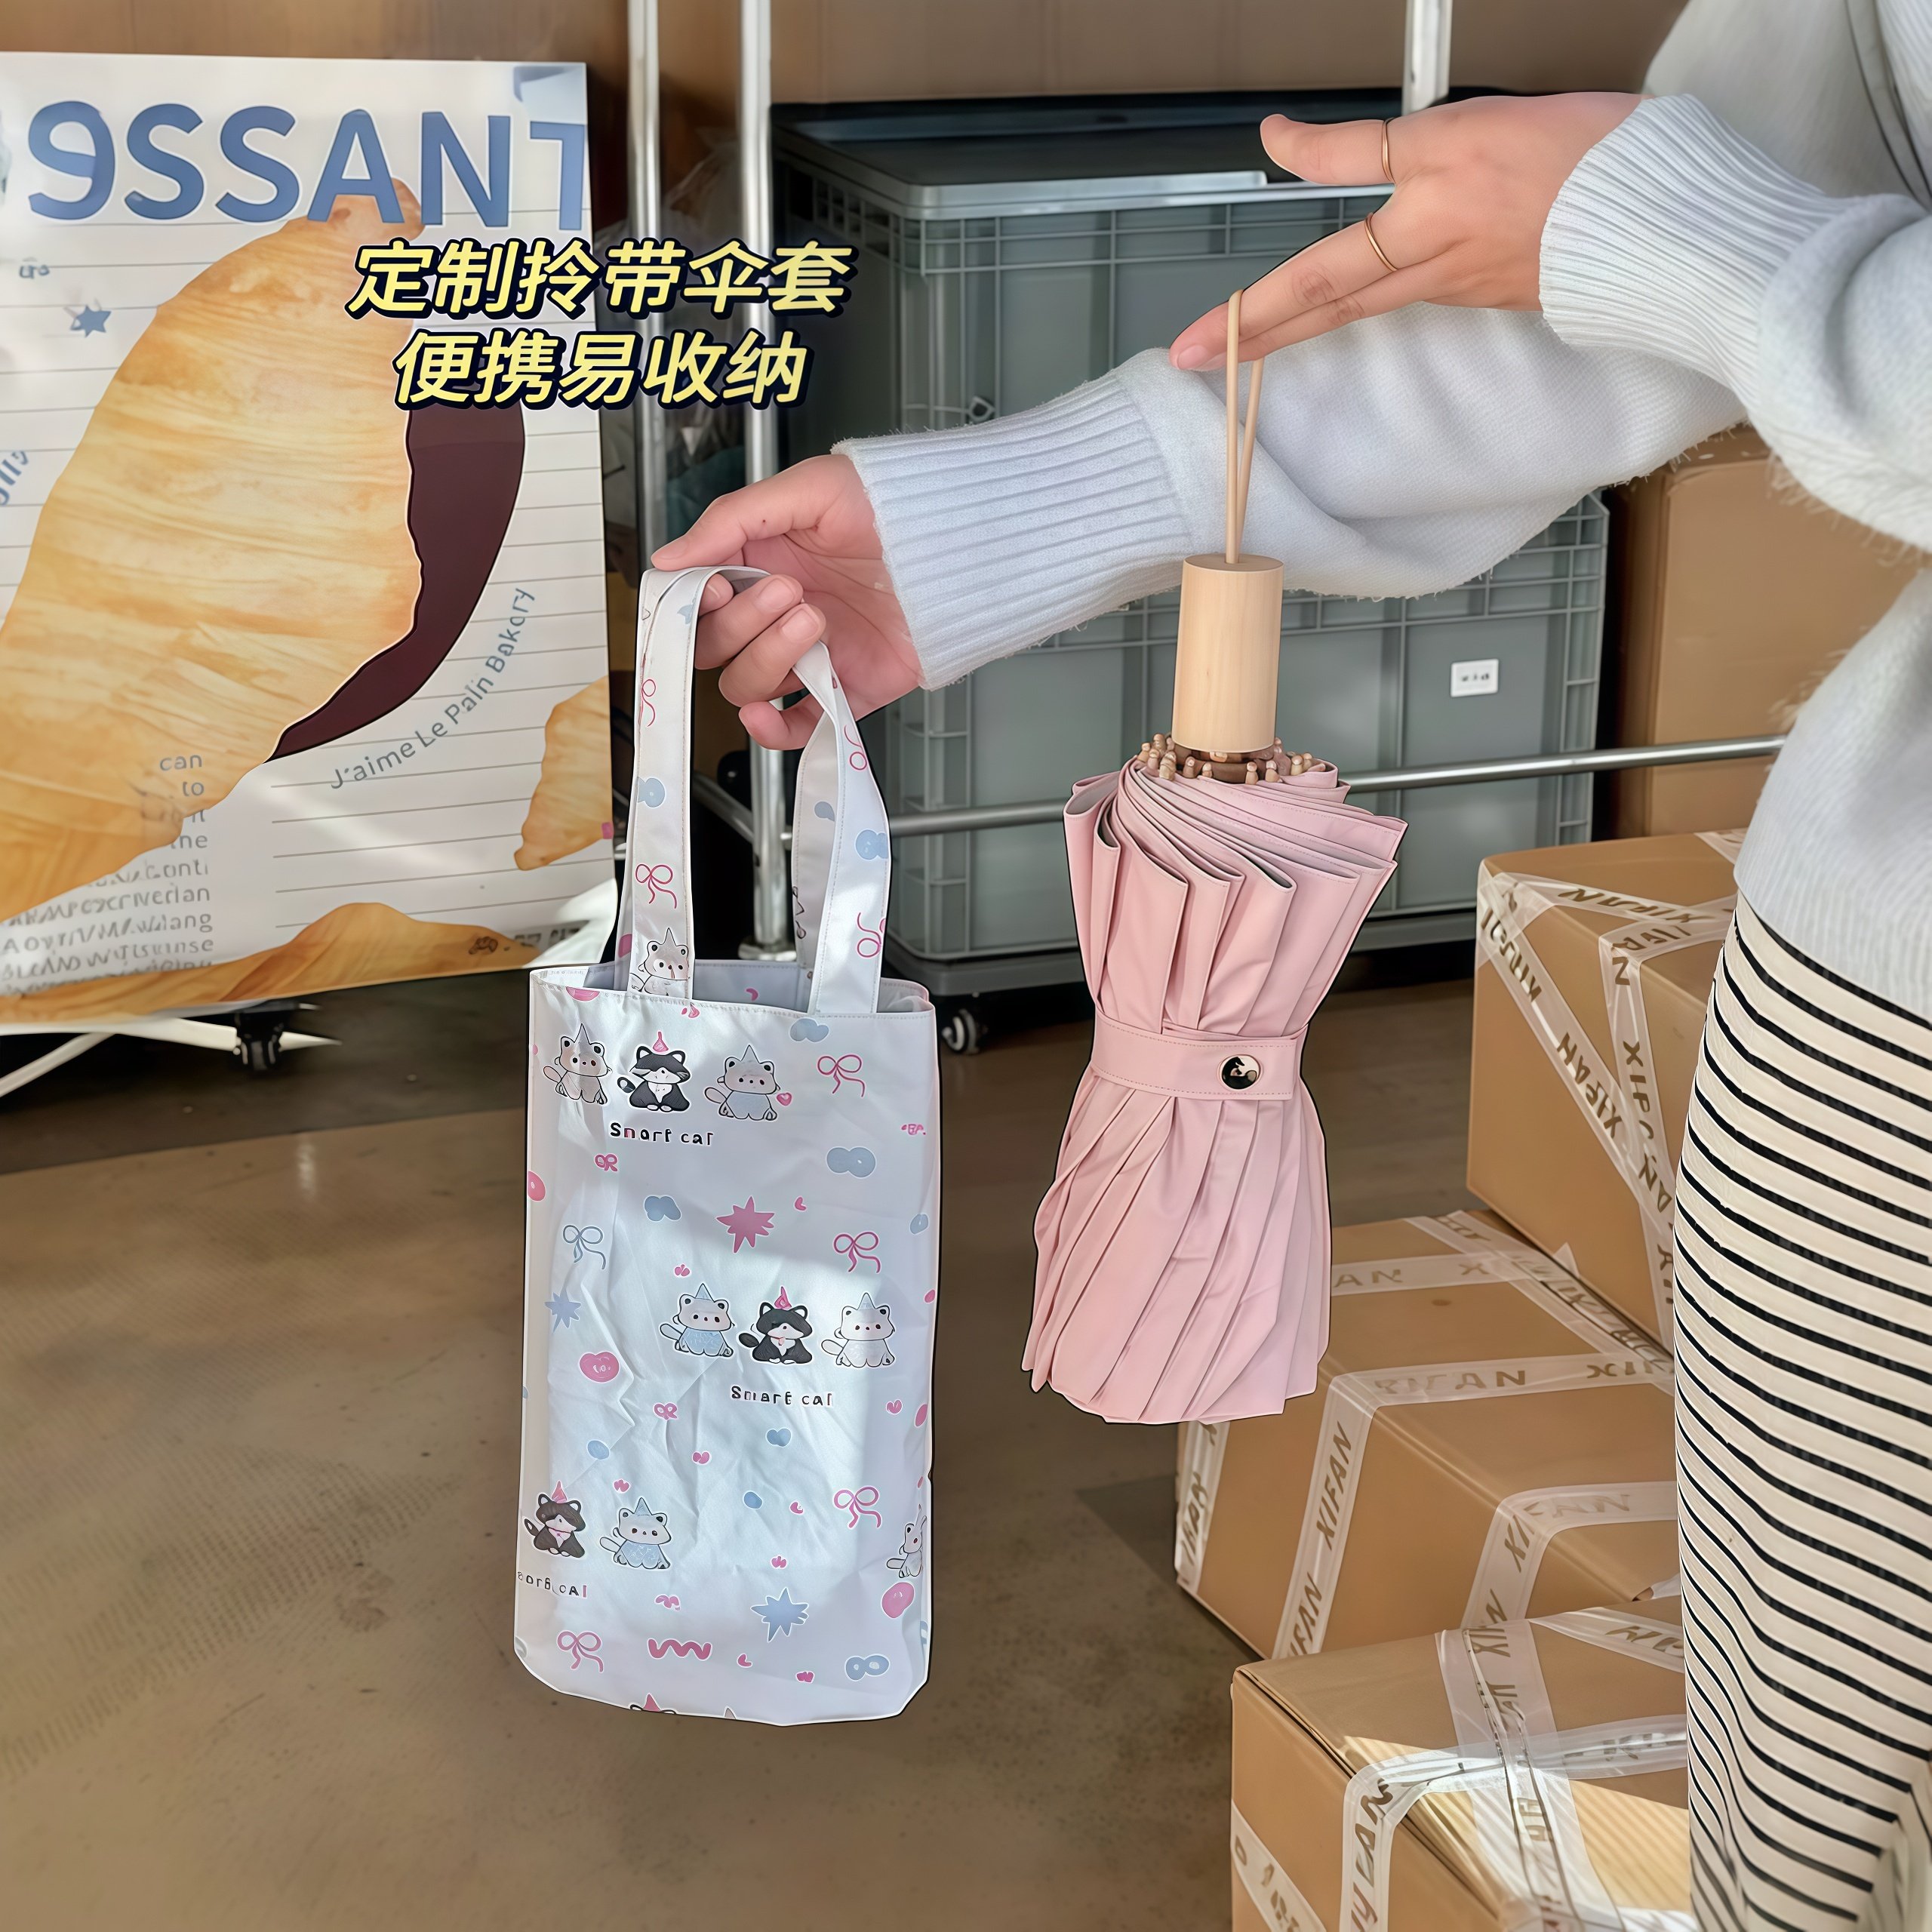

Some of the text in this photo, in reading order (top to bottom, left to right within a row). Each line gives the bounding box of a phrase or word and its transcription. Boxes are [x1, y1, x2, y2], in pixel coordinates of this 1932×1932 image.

[415, 721, 448, 748] Le
[159, 754, 203, 771] can
[1315, 1420, 1352, 1552] XIFAN
